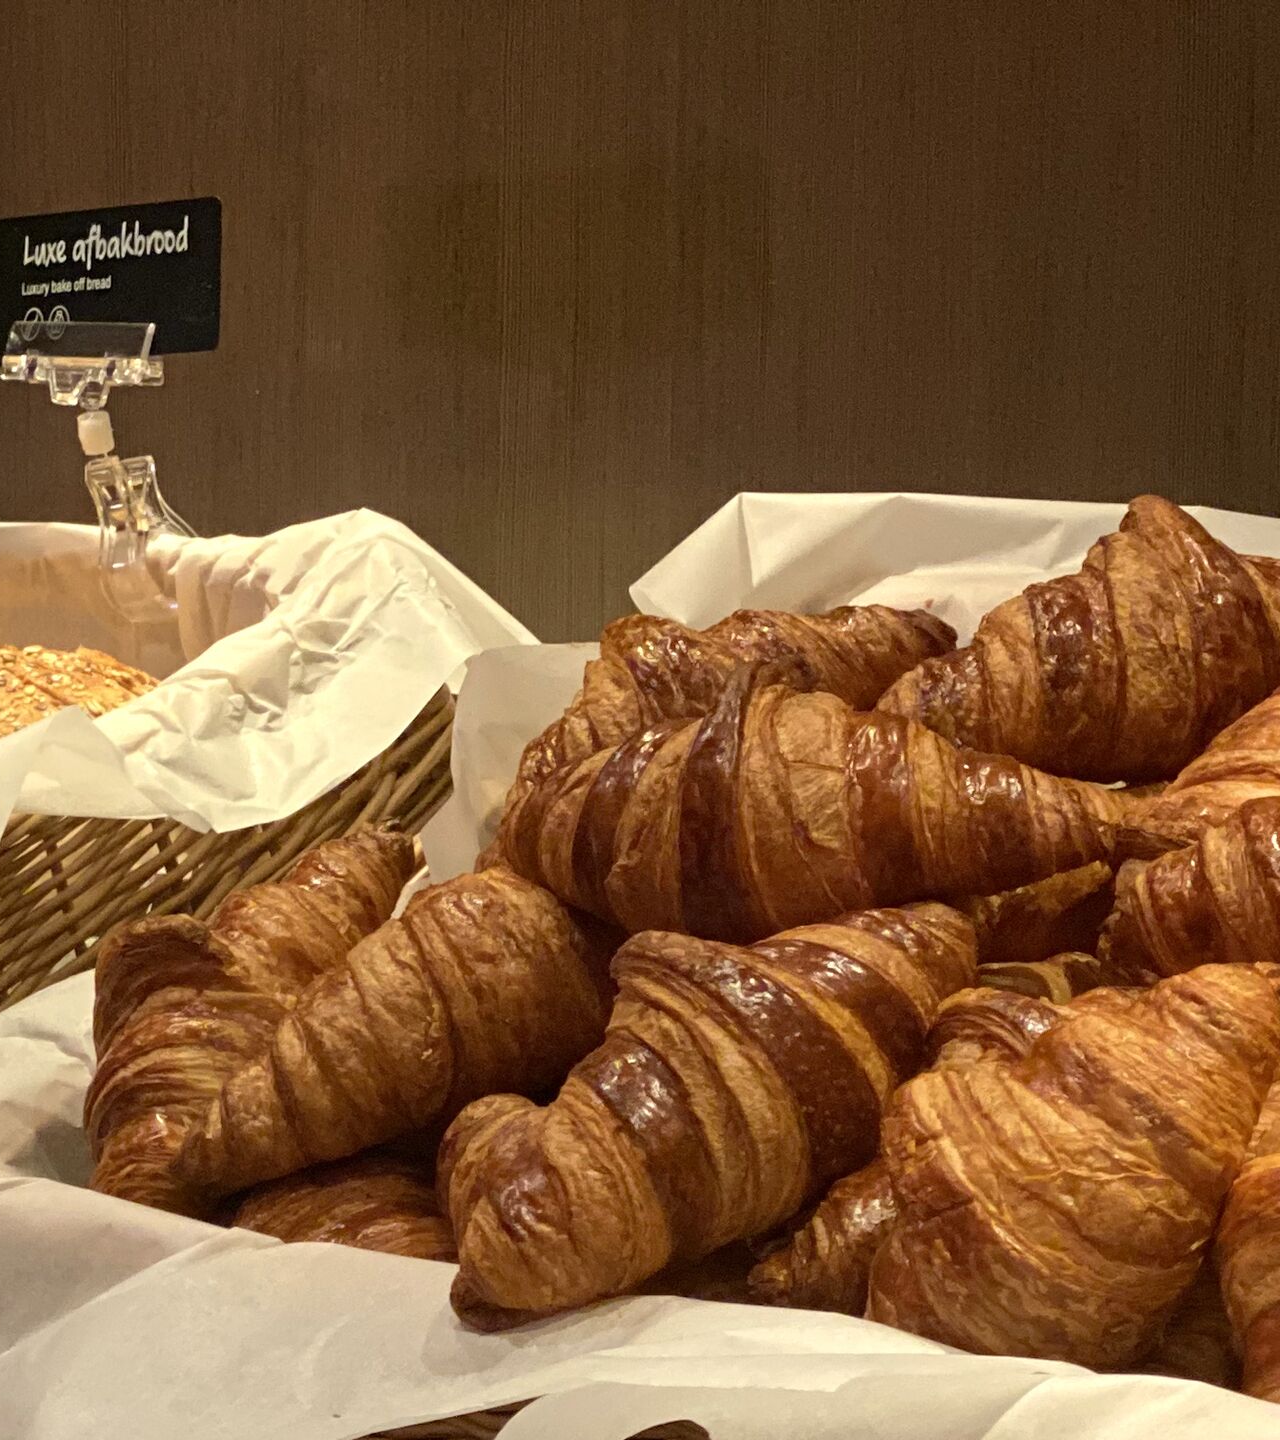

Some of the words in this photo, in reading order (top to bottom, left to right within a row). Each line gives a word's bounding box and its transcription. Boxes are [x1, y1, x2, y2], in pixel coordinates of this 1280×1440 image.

[23, 236, 67, 267] Luxe
[72, 215, 189, 271] afbakbrood
[21, 282, 50, 297] Luxury
[51, 279, 72, 294] bake
[73, 278, 86, 291] off
[87, 275, 112, 290] bread
